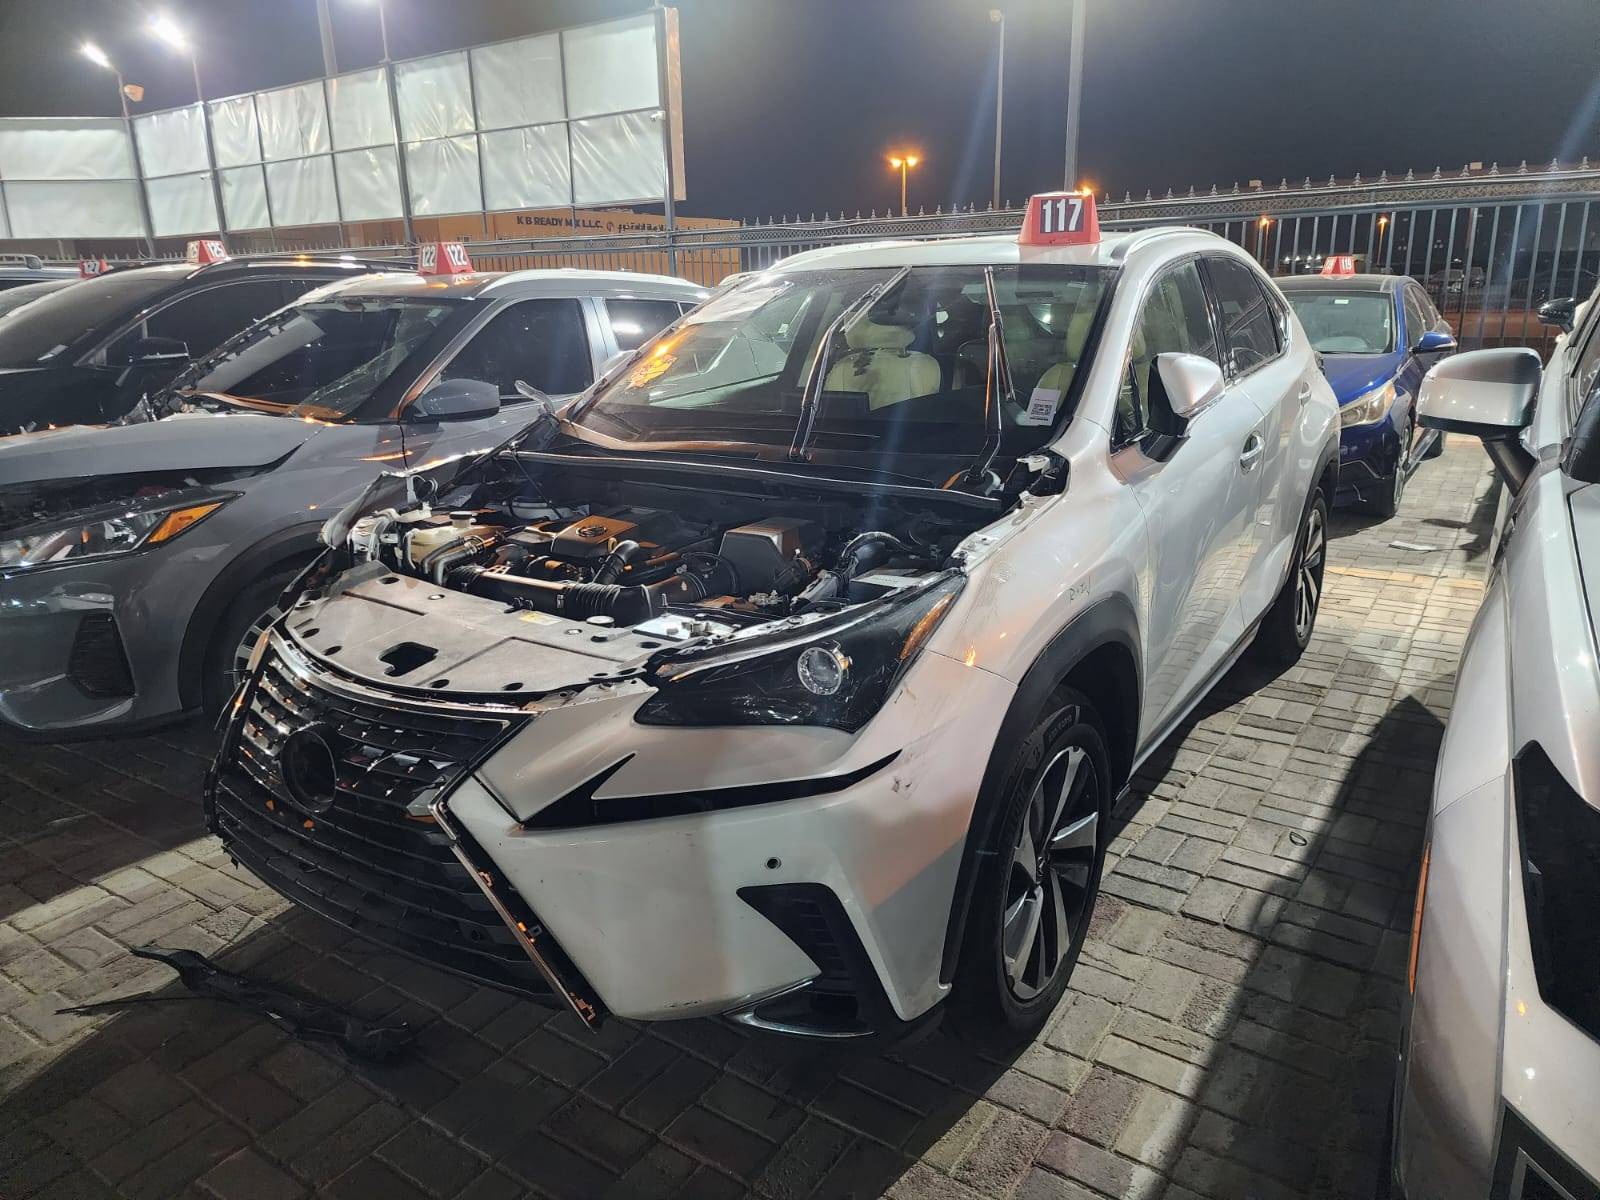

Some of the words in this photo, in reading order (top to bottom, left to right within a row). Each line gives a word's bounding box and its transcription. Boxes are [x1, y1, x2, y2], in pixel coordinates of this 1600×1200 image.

[516, 215, 524, 225] K
[525, 216, 533, 225] B
[534, 217, 563, 226] READY
[565, 218, 581, 228] MX
[1043, 199, 1082, 232] 117
[207, 242, 226, 258] 125
[422, 244, 436, 267] 122
[446, 244, 468, 266] 122
